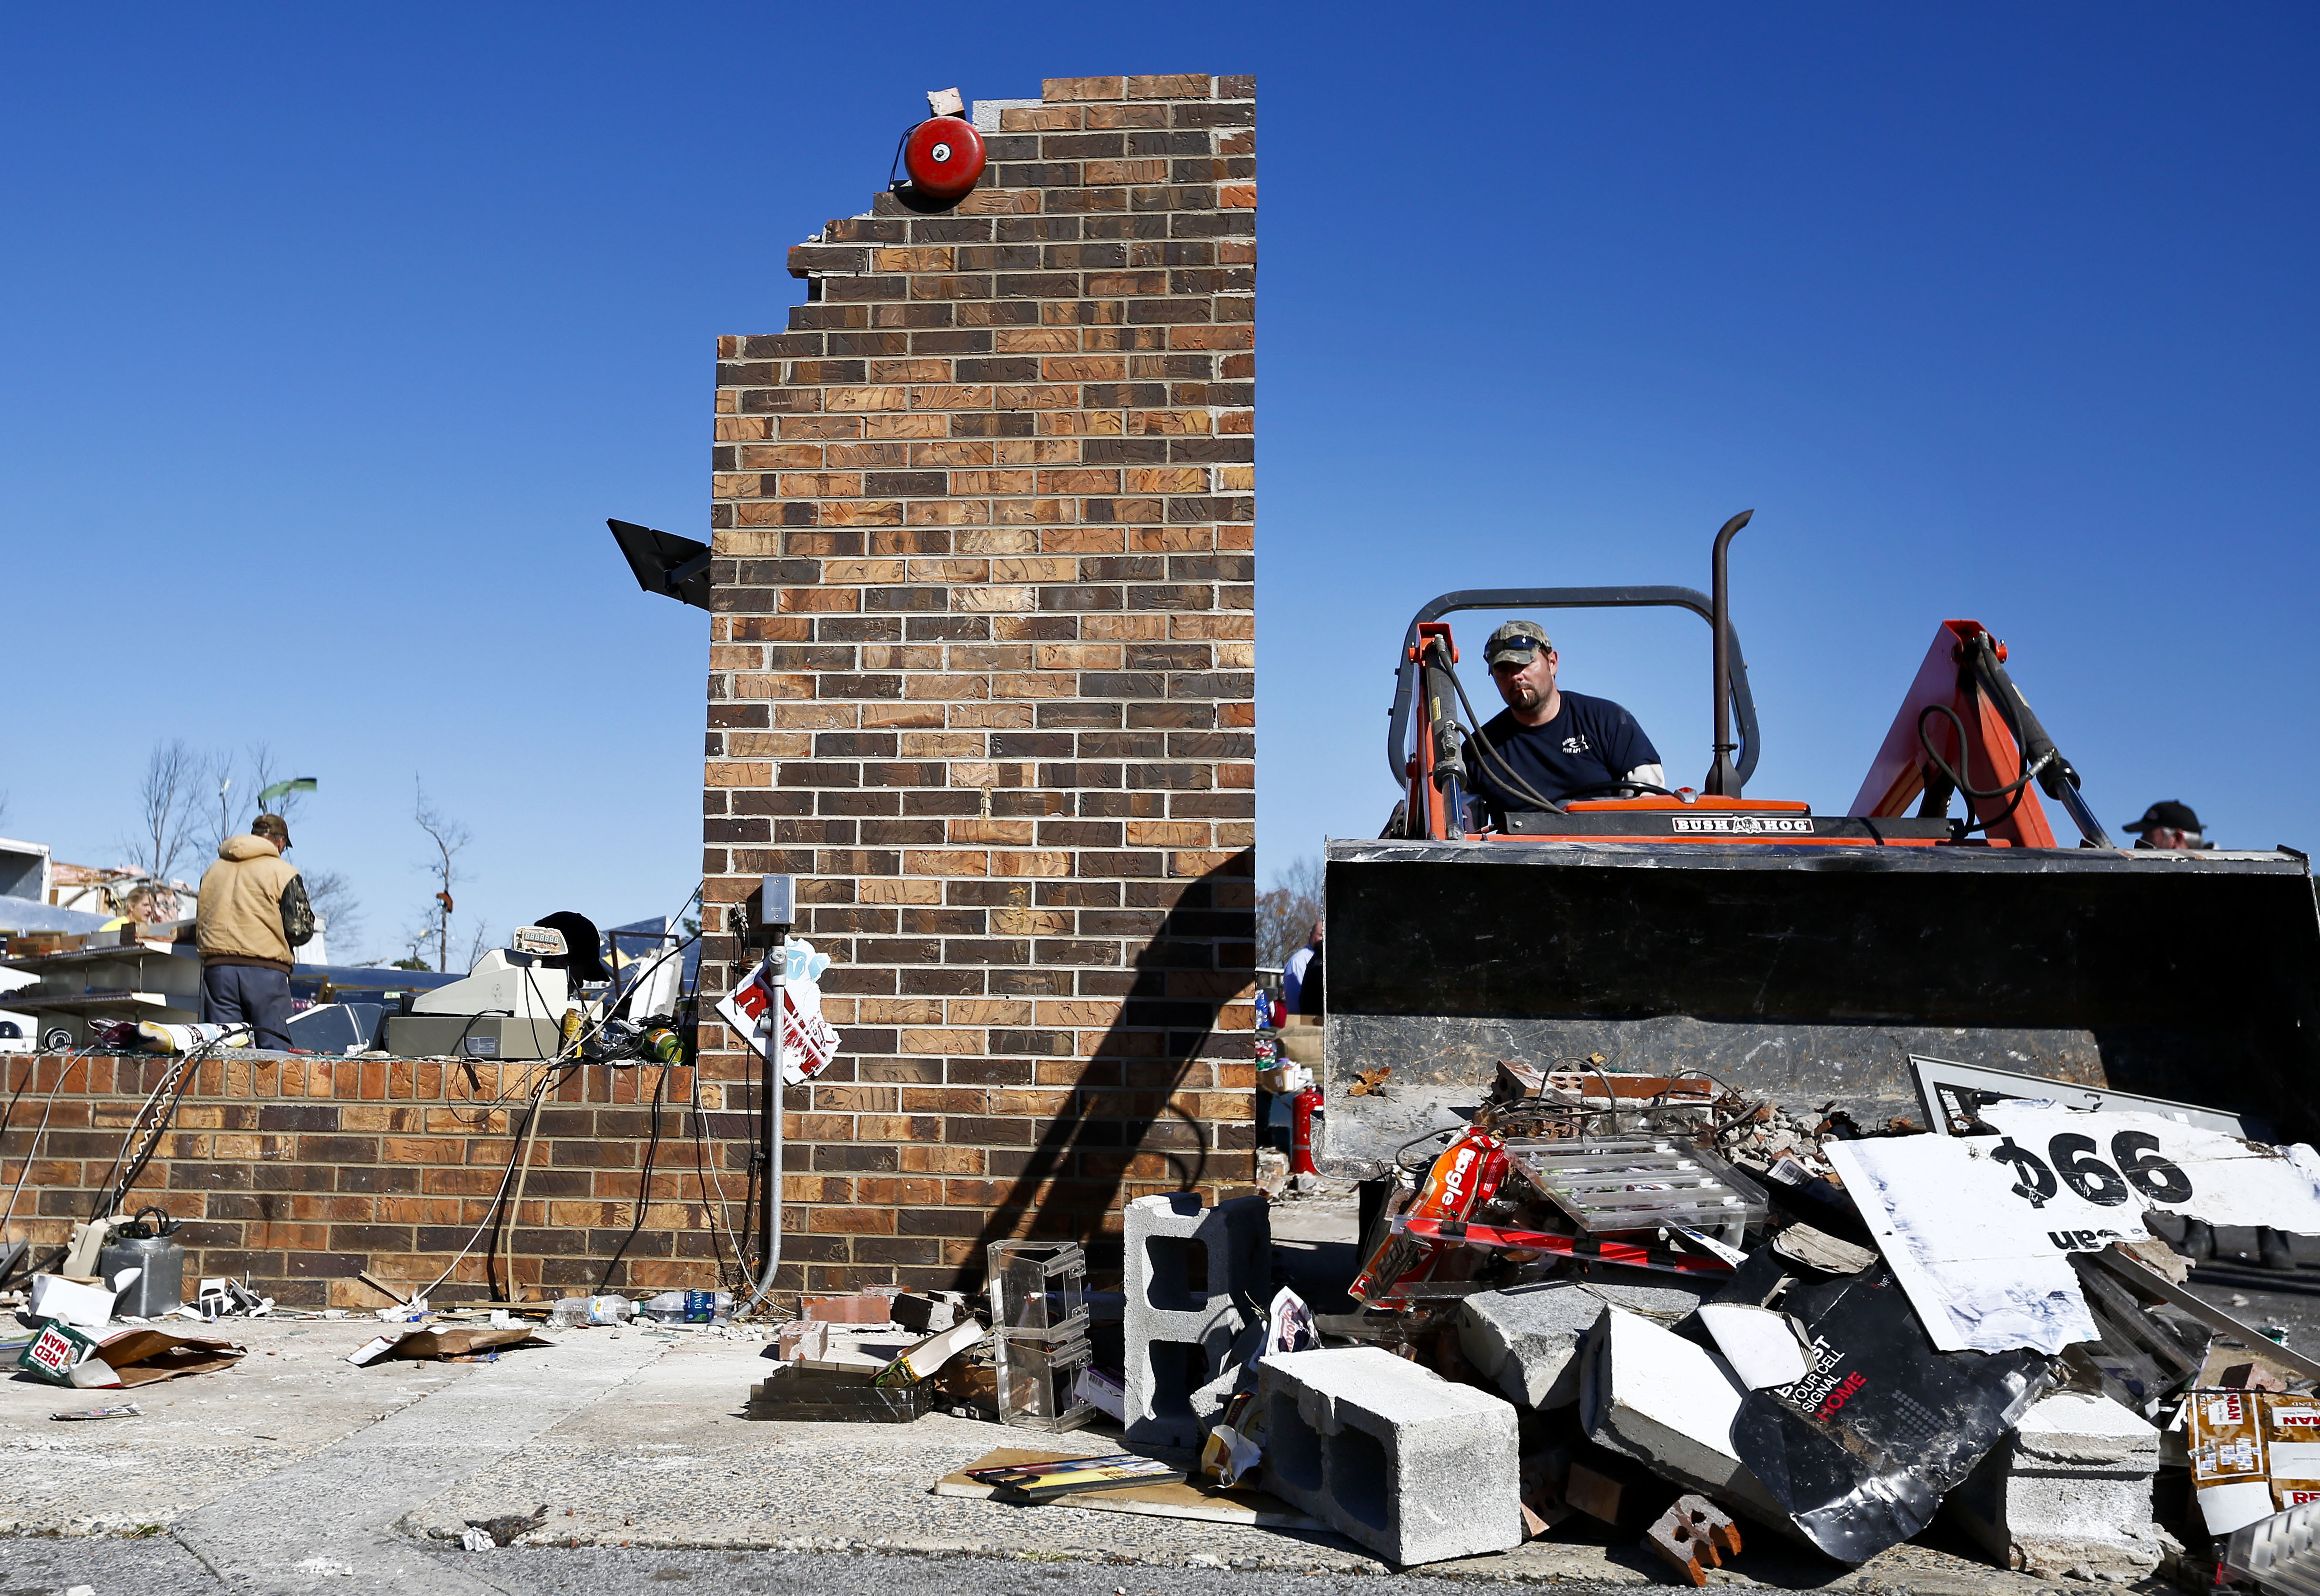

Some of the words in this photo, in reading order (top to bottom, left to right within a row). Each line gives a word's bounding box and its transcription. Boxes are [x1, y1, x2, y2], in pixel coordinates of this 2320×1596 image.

[1677, 820, 1729, 830] BUSH
[1763, 820, 1807, 831] HOG
[1442, 1148, 1476, 1205] Eagle
[35, 1345, 61, 1367] RED
[41, 1332, 68, 1355] MAN
[1774, 1335, 1831, 1398] BST
[1788, 1374, 1821, 1405] YOUR
[1816, 1350, 1845, 1374] CELL
[1802, 1375, 1842, 1413] SIGNAL
[1814, 1371, 1867, 1422] HOME
[2227, 1394, 2241, 1420] MAN
